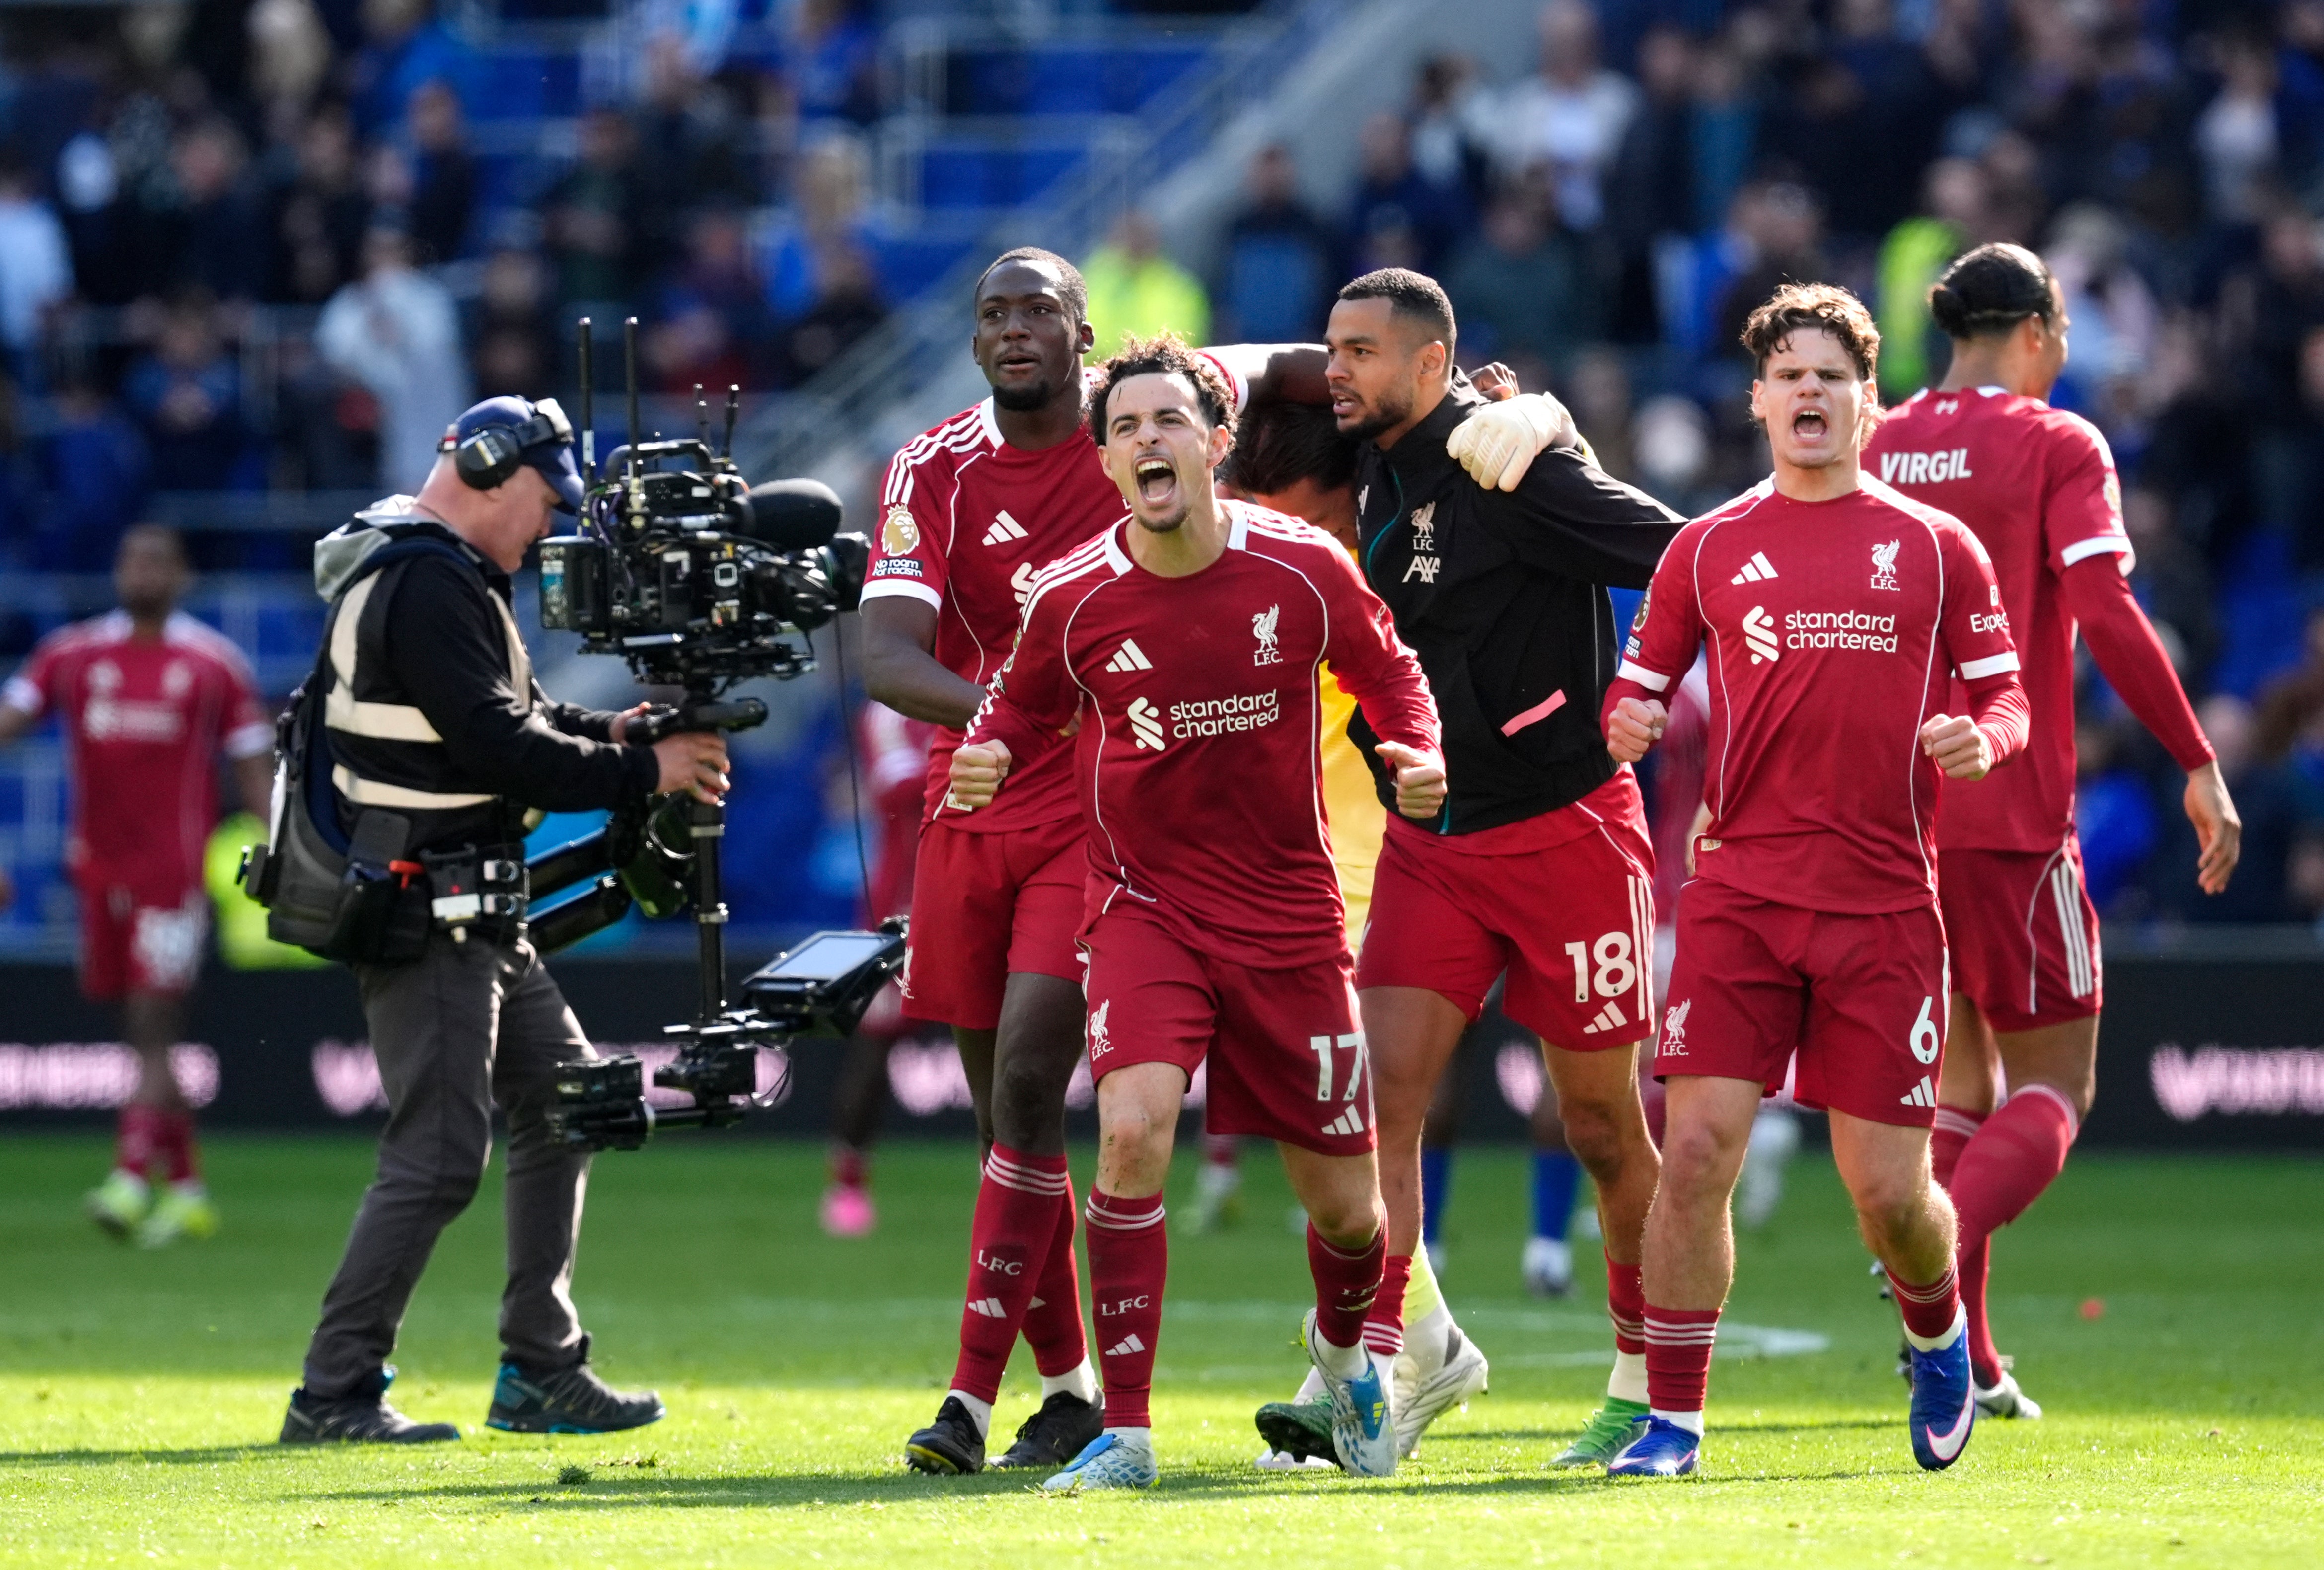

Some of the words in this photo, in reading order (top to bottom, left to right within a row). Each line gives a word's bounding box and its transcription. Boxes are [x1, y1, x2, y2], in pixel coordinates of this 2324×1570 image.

[1881, 448, 1972, 484] VIRGIL
[875, 559, 888, 569] No
[889, 559, 919, 569] room
[887, 567, 923, 577] racism
[1402, 555, 1440, 583] AXA
[1870, 578, 1900, 591] L.F.C.
[1785, 610, 1895, 633] standard
[1787, 629, 1898, 653] chartered
[1254, 651, 1283, 666] L.F.C.
[1170, 688, 1276, 721] standard
[1173, 704, 1279, 738] chartered
[1565, 931, 1636, 1002] 18
[1910, 996, 1939, 1064] 6
[1663, 1045, 1689, 1056] L.F.C.
[1310, 1032, 1364, 1101] 17
[977, 1249, 1022, 1275] LFC
[1102, 1295, 1148, 1316] LFC
